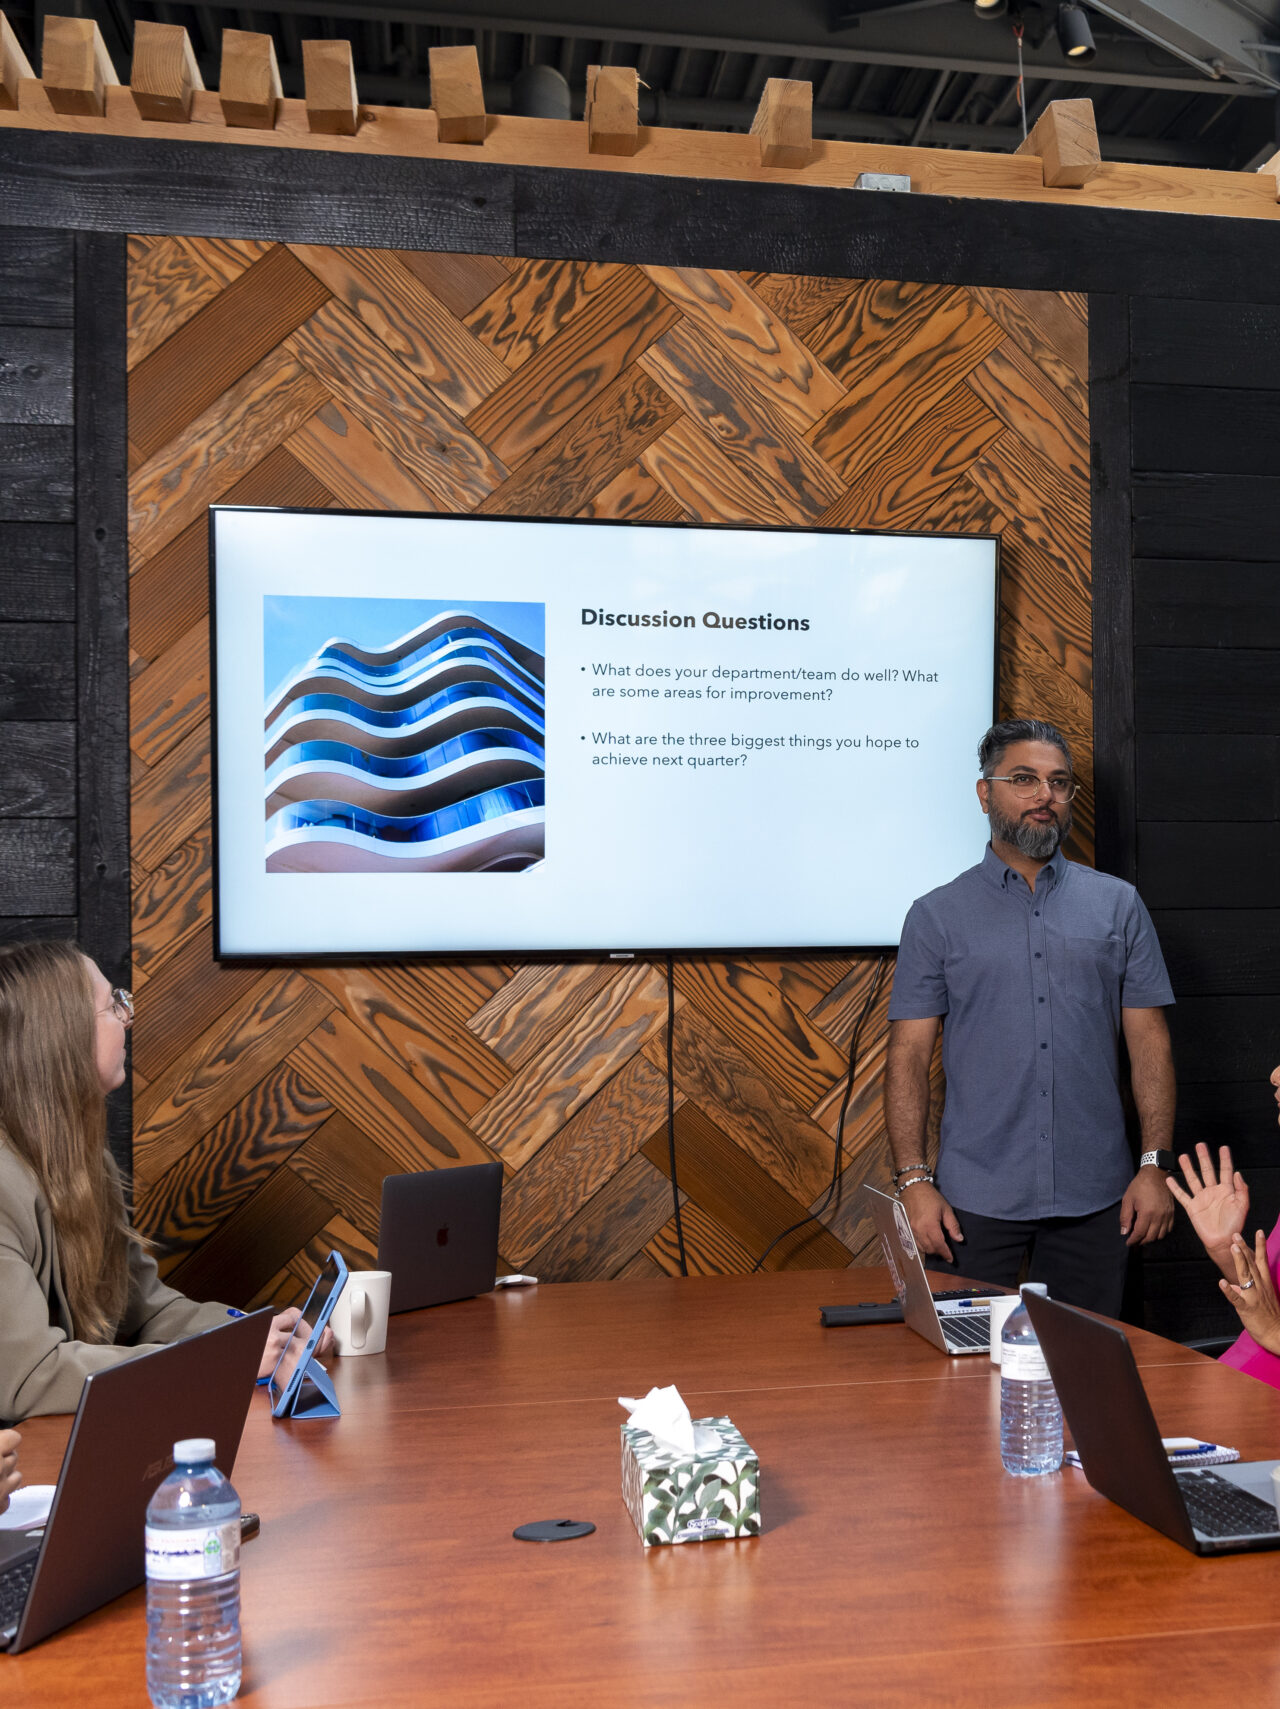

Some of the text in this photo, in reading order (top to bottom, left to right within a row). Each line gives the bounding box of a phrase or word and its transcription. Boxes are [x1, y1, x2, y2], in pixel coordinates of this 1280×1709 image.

[581, 607, 811, 632] Discussion Questions
[591, 662, 939, 683] What does your department/team do well? What
[591, 685, 833, 704] are some areas for improvement?
[591, 730, 920, 752] What are the three biggest things you hope to
[591, 751, 748, 770] achieve next quarter?
